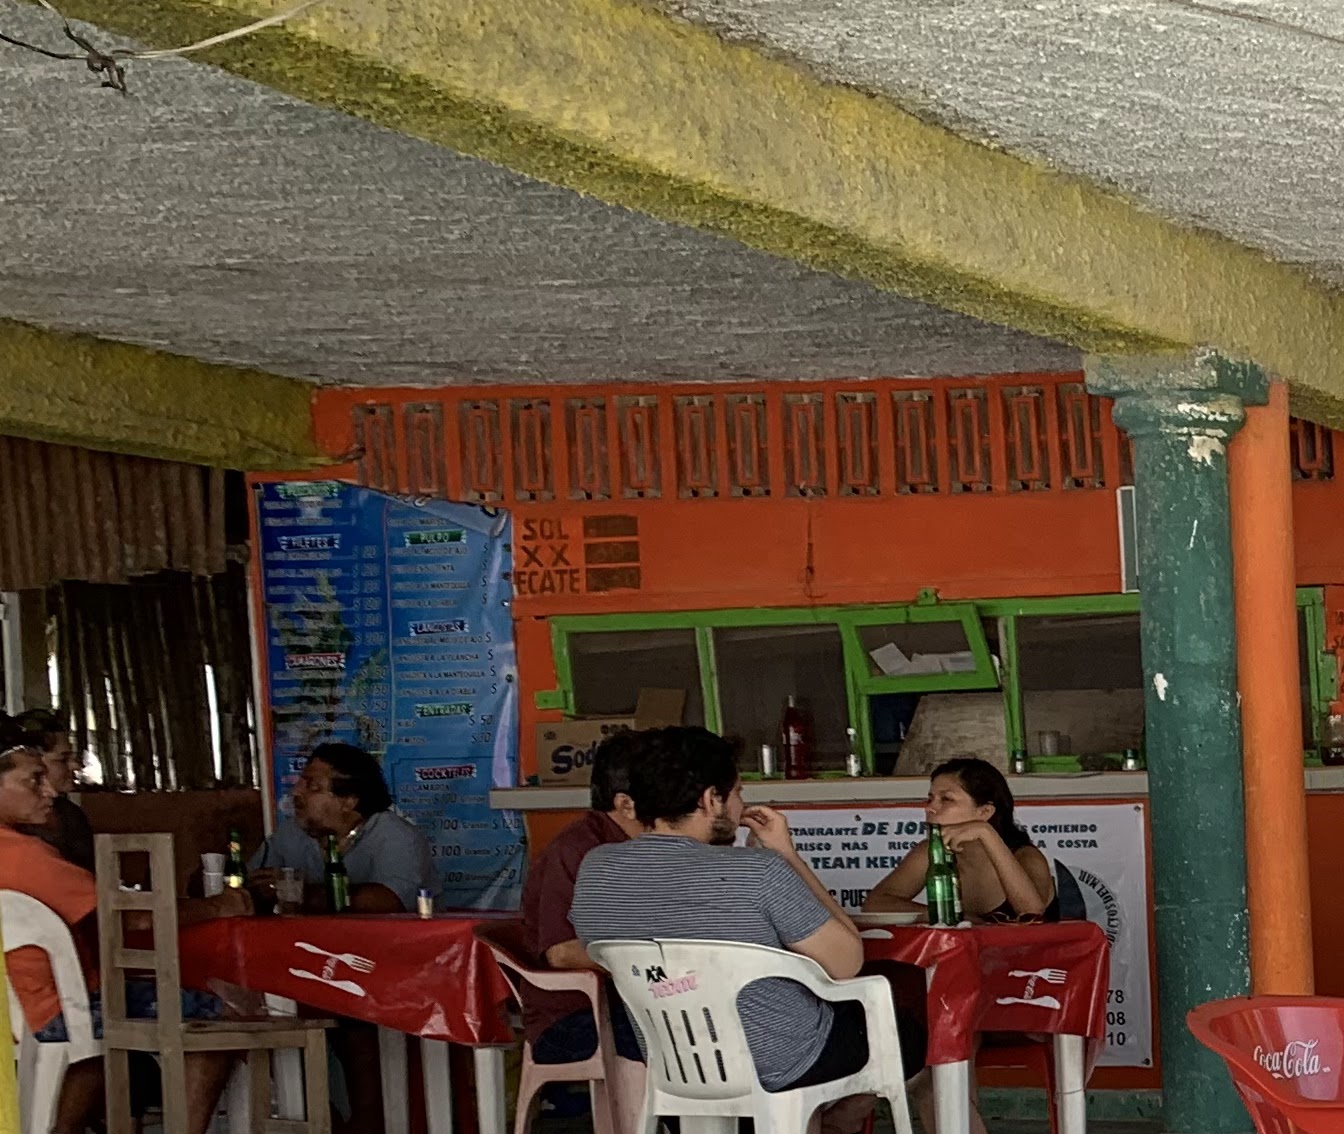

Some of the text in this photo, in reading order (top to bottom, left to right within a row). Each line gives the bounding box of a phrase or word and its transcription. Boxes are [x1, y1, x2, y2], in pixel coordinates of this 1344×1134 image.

[420, 532, 450, 543] PULPO
[522, 518, 569, 541] SOL
[513, 568, 581, 595] ECATE
[551, 740, 598, 775] Sod
[789, 827, 858, 837] STAURANTE
[861, 821, 890, 836] DE
[1031, 823, 1098, 834] COMIENDO
[795, 841, 832, 852] RISCO
[1057, 839, 1099, 849] COSTA
[811, 856, 861, 870] TEAM
[1078, 869, 1101, 890] MAR
[1107, 1011, 1126, 1025] 08
[1107, 1031, 1126, 1046] 10
[1253, 1039, 1322, 1080] Coca-Cola
